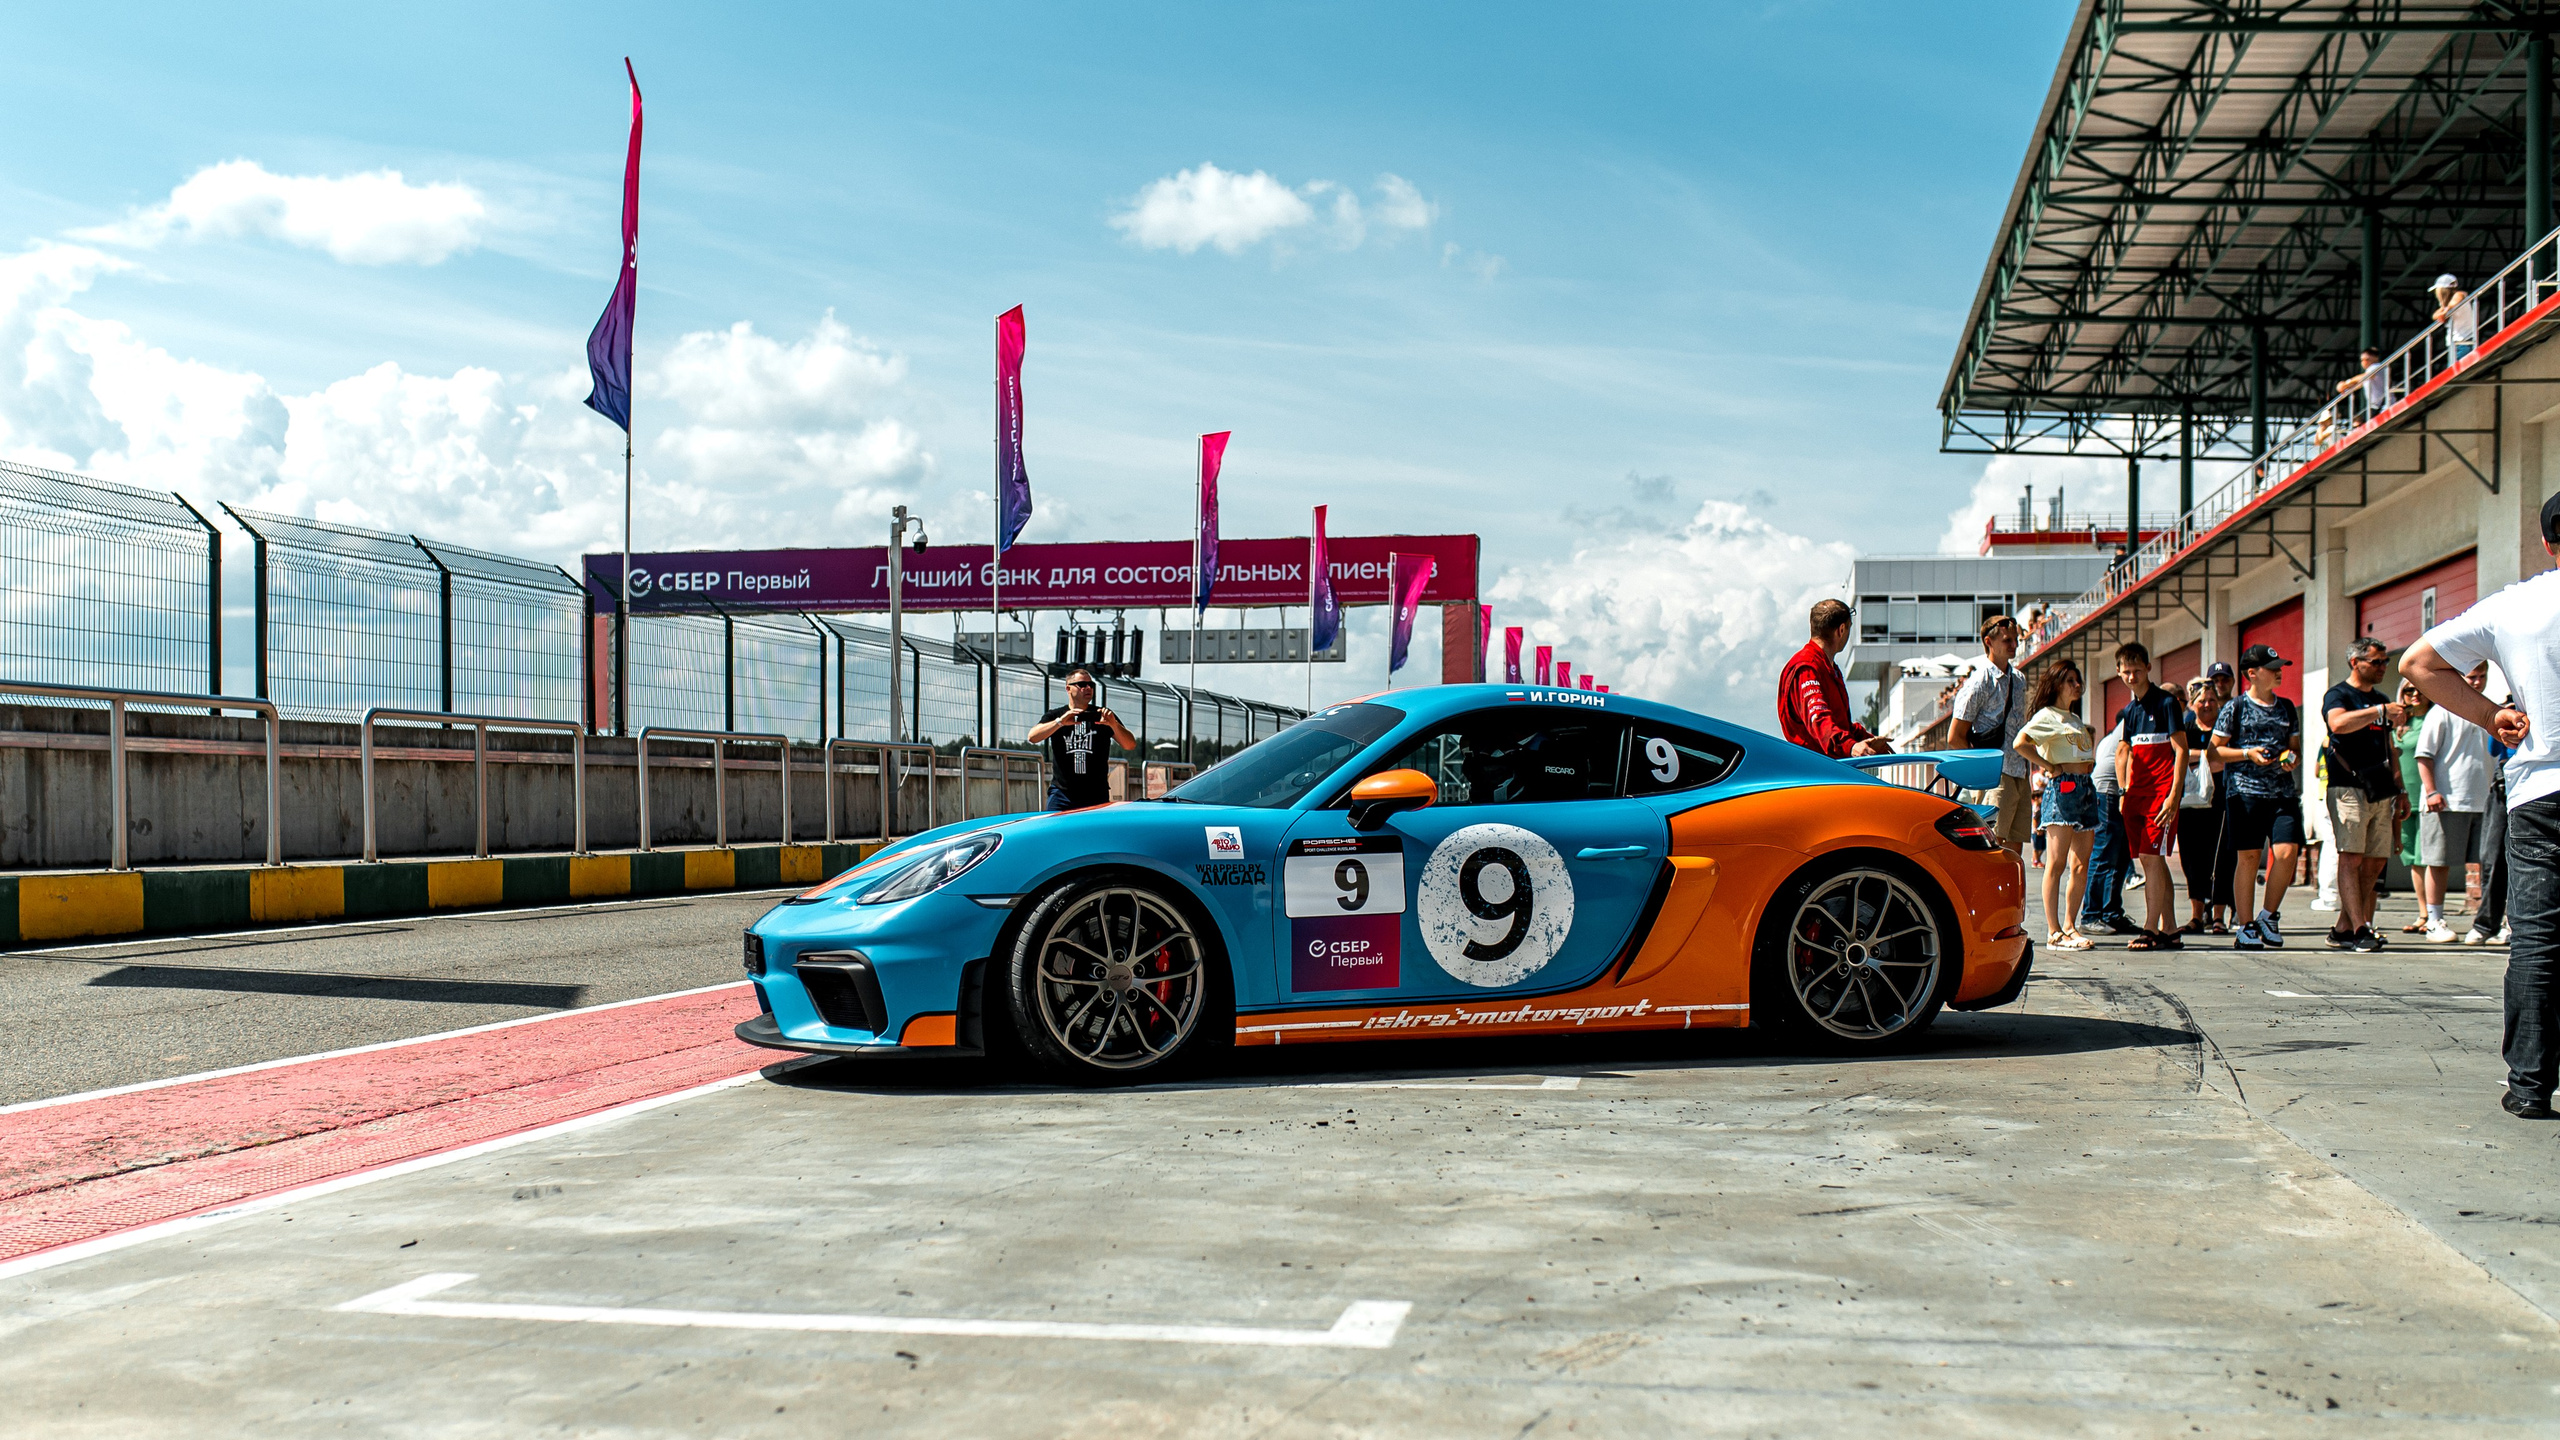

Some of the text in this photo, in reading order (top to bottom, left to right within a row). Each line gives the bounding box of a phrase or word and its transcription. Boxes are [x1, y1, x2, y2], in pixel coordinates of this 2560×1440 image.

[658, 569, 810, 593] СБЕР Первый
[981, 563, 1041, 586] банк
[1049, 567, 1096, 588] для
[1104, 562, 1302, 585] состояльных
[1328, 560, 1438, 581] лиенв
[1530, 691, 1605, 707] И.ГОРИН
[1645, 737, 1680, 783] 9
[1545, 765, 1575, 775] RECARO
[1195, 864, 1262, 873] WRAPPED BY
[1201, 870, 1266, 886] AMGAR
[1335, 858, 1370, 911] 9
[1459, 847, 1534, 962] 9
[1330, 940, 1370, 953] СБЕР
[1331, 953, 1383, 969] Первый
